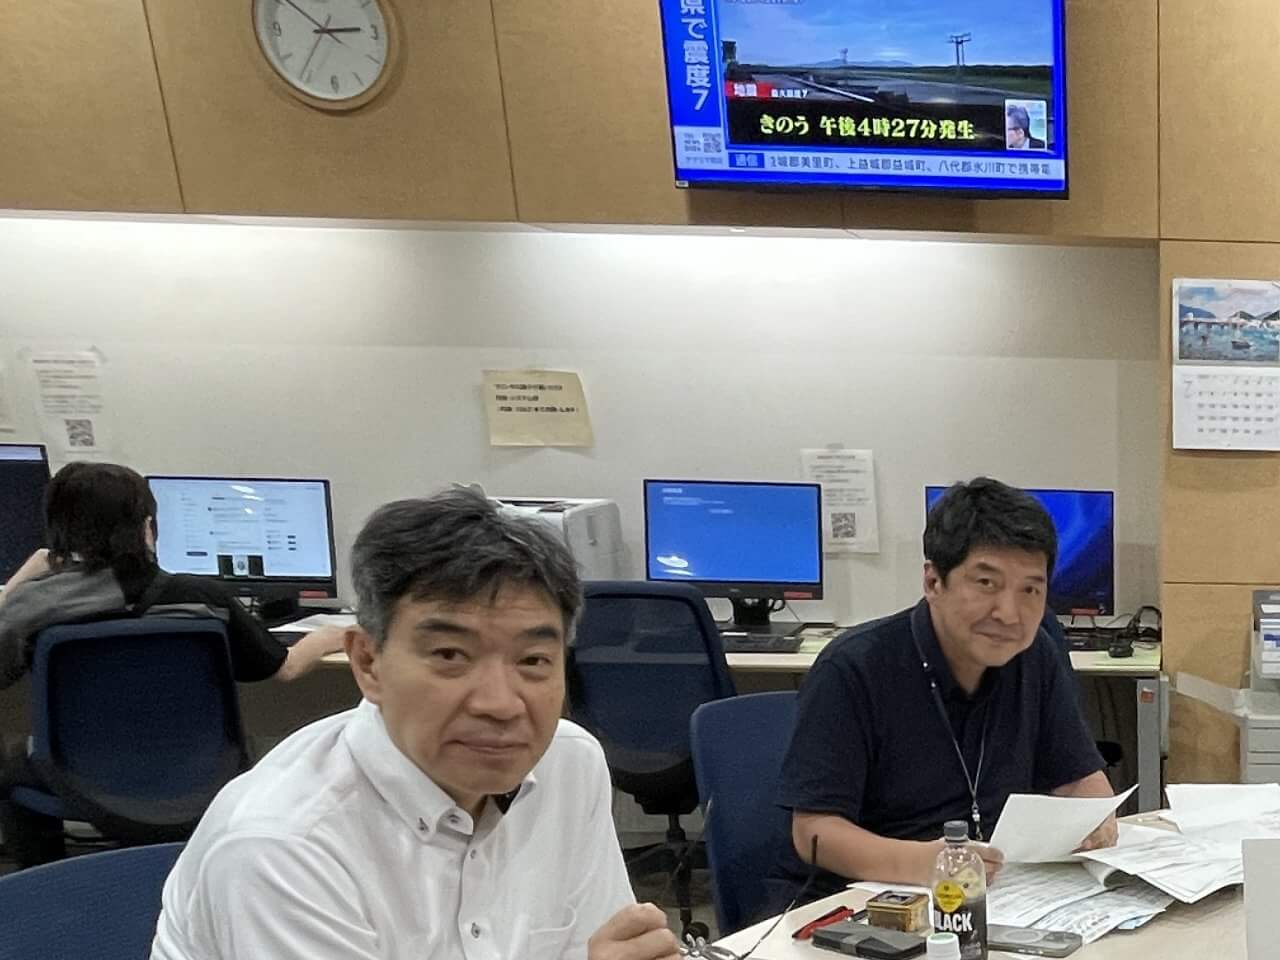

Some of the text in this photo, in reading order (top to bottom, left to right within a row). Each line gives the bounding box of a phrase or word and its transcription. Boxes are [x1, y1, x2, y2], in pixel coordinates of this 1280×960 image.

[760, 114, 976, 141] きのう 午後4時27分発生
